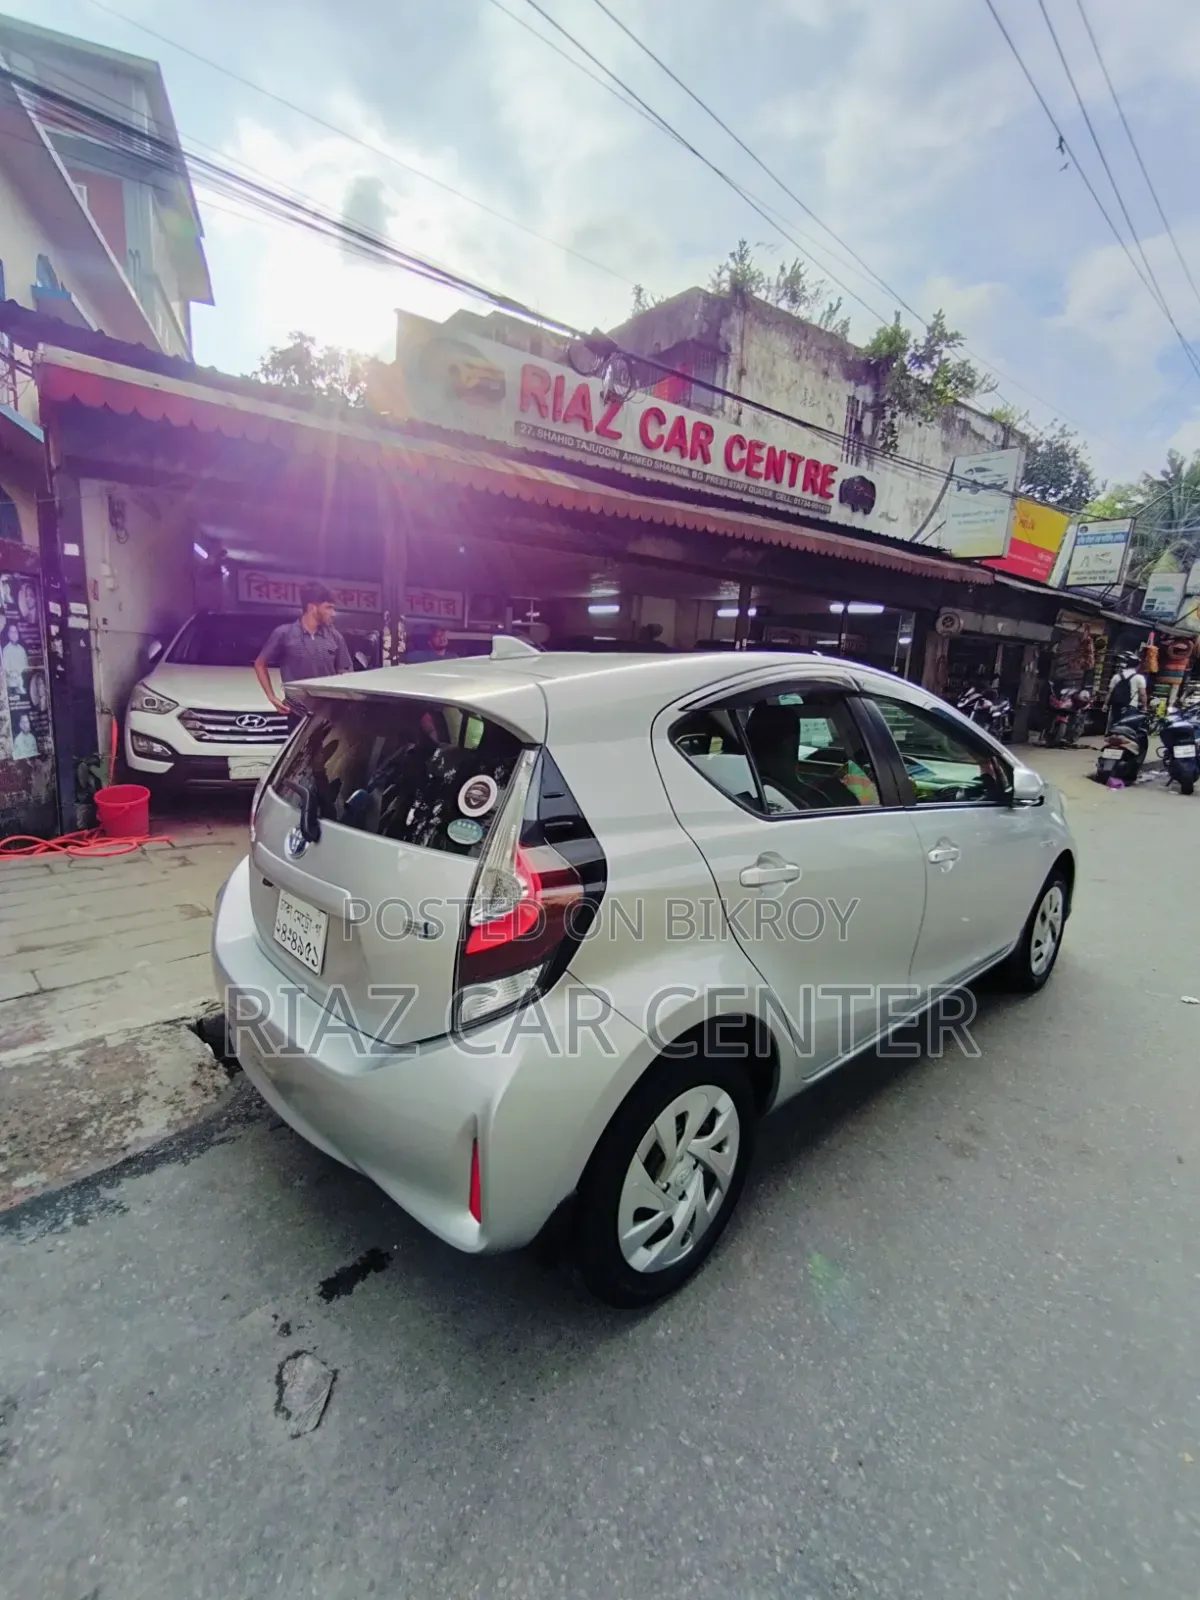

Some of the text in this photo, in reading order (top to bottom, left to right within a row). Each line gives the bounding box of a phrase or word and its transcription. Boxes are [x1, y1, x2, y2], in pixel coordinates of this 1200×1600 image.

[519, 363, 839, 500] RIAZ CAR CENTRE
[537, 428, 575, 446] SHAHID
[576, 439, 620, 459] TAJUDDIN
[622, 452, 654, 468] AHMED
[706, 474, 729, 488] PRESS
[728, 480, 749, 493] STAFF
